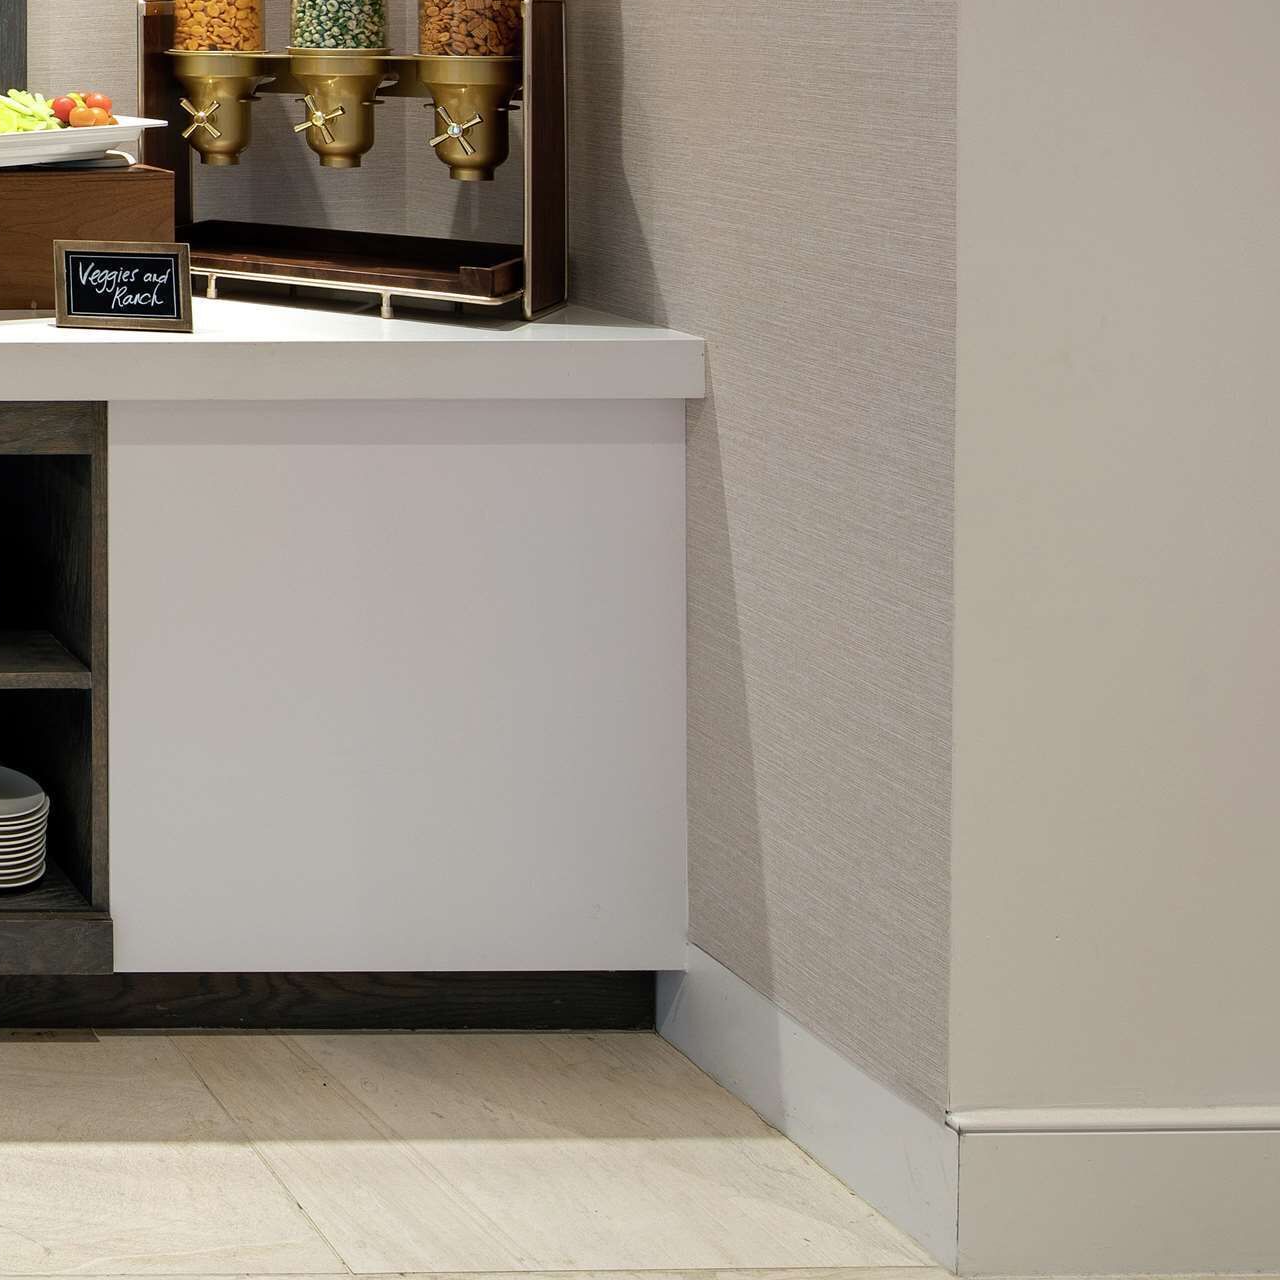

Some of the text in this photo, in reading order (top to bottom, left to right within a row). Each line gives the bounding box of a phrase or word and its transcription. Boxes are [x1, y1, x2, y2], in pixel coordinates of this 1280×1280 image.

[79, 262, 171, 293] Veggies and
[111, 283, 164, 309] Ranch
